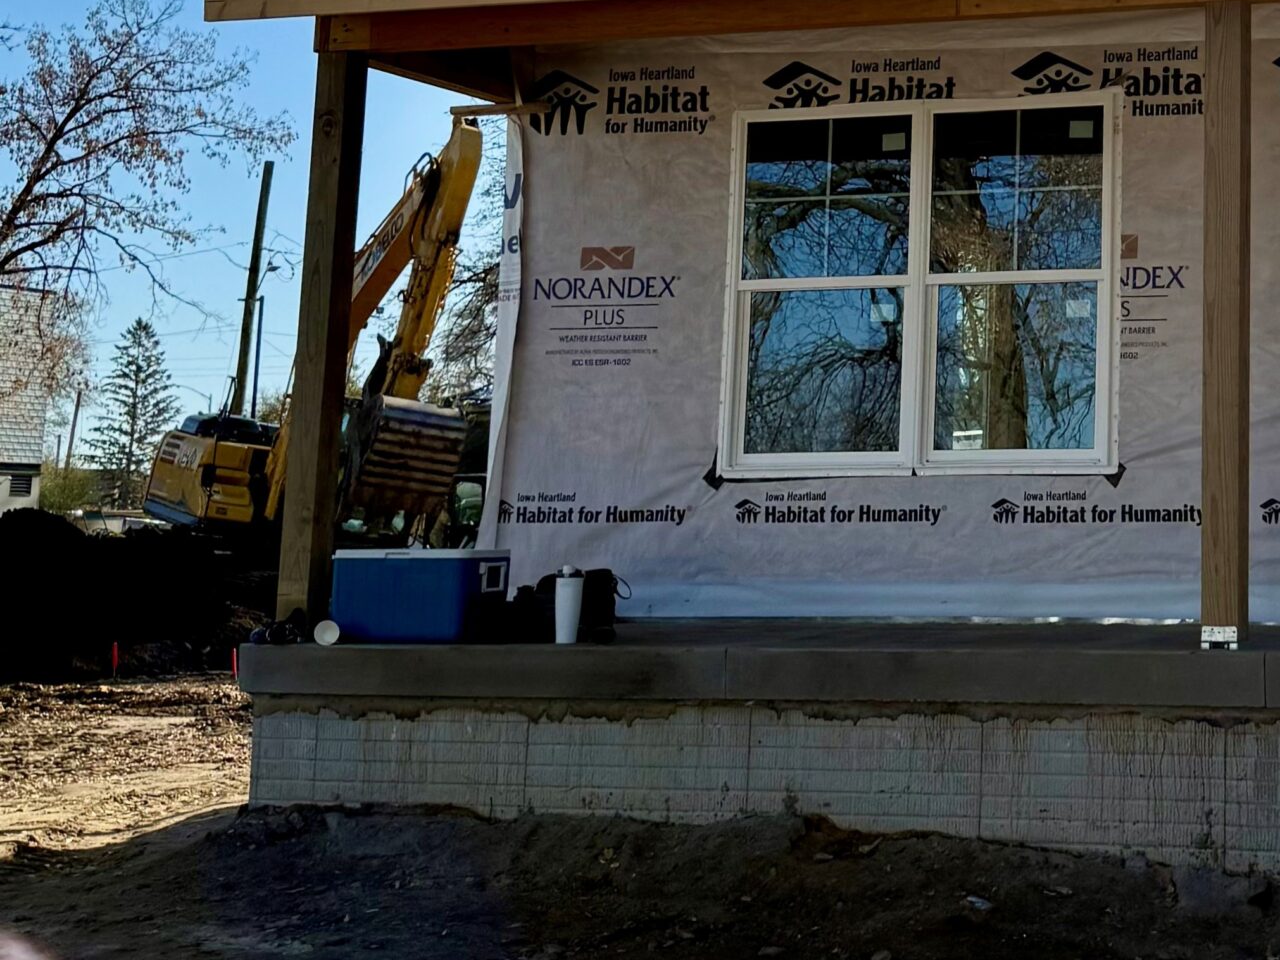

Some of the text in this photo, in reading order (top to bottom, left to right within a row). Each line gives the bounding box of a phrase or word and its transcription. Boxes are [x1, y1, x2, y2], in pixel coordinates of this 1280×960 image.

[1104, 46, 1198, 63] Iowa Heartland
[851, 56, 941, 73] Iowa Heartland
[609, 65, 695, 83] Iowa Heartland
[1100, 66, 1205, 97] Habita
[848, 75, 956, 103] Habitat
[606, 83, 710, 116] Habitat
[1132, 97, 1204, 117] Humanit
[605, 116, 709, 135] for Humanity
[1120, 266, 1185, 289] NDEX
[533, 275, 677, 301] NORANDEX
[583, 308, 625, 326] PLUS
[558, 333, 647, 344] WEATHER RESISTANT BARRIER
[1128, 326, 1156, 335] BARRIER
[572, 358, 584, 367] ICC
[517, 492, 576, 503] Iowa Heartland
[765, 491, 827, 502] Iowa Heartland
[1023, 490, 1087, 502] Iowa Heartland
[515, 504, 687, 526] Habitat for Humanity
[764, 504, 942, 526] Habitat for Humanity
[1022, 505, 1087, 524] Habitat
[1091, 505, 1117, 523] for
